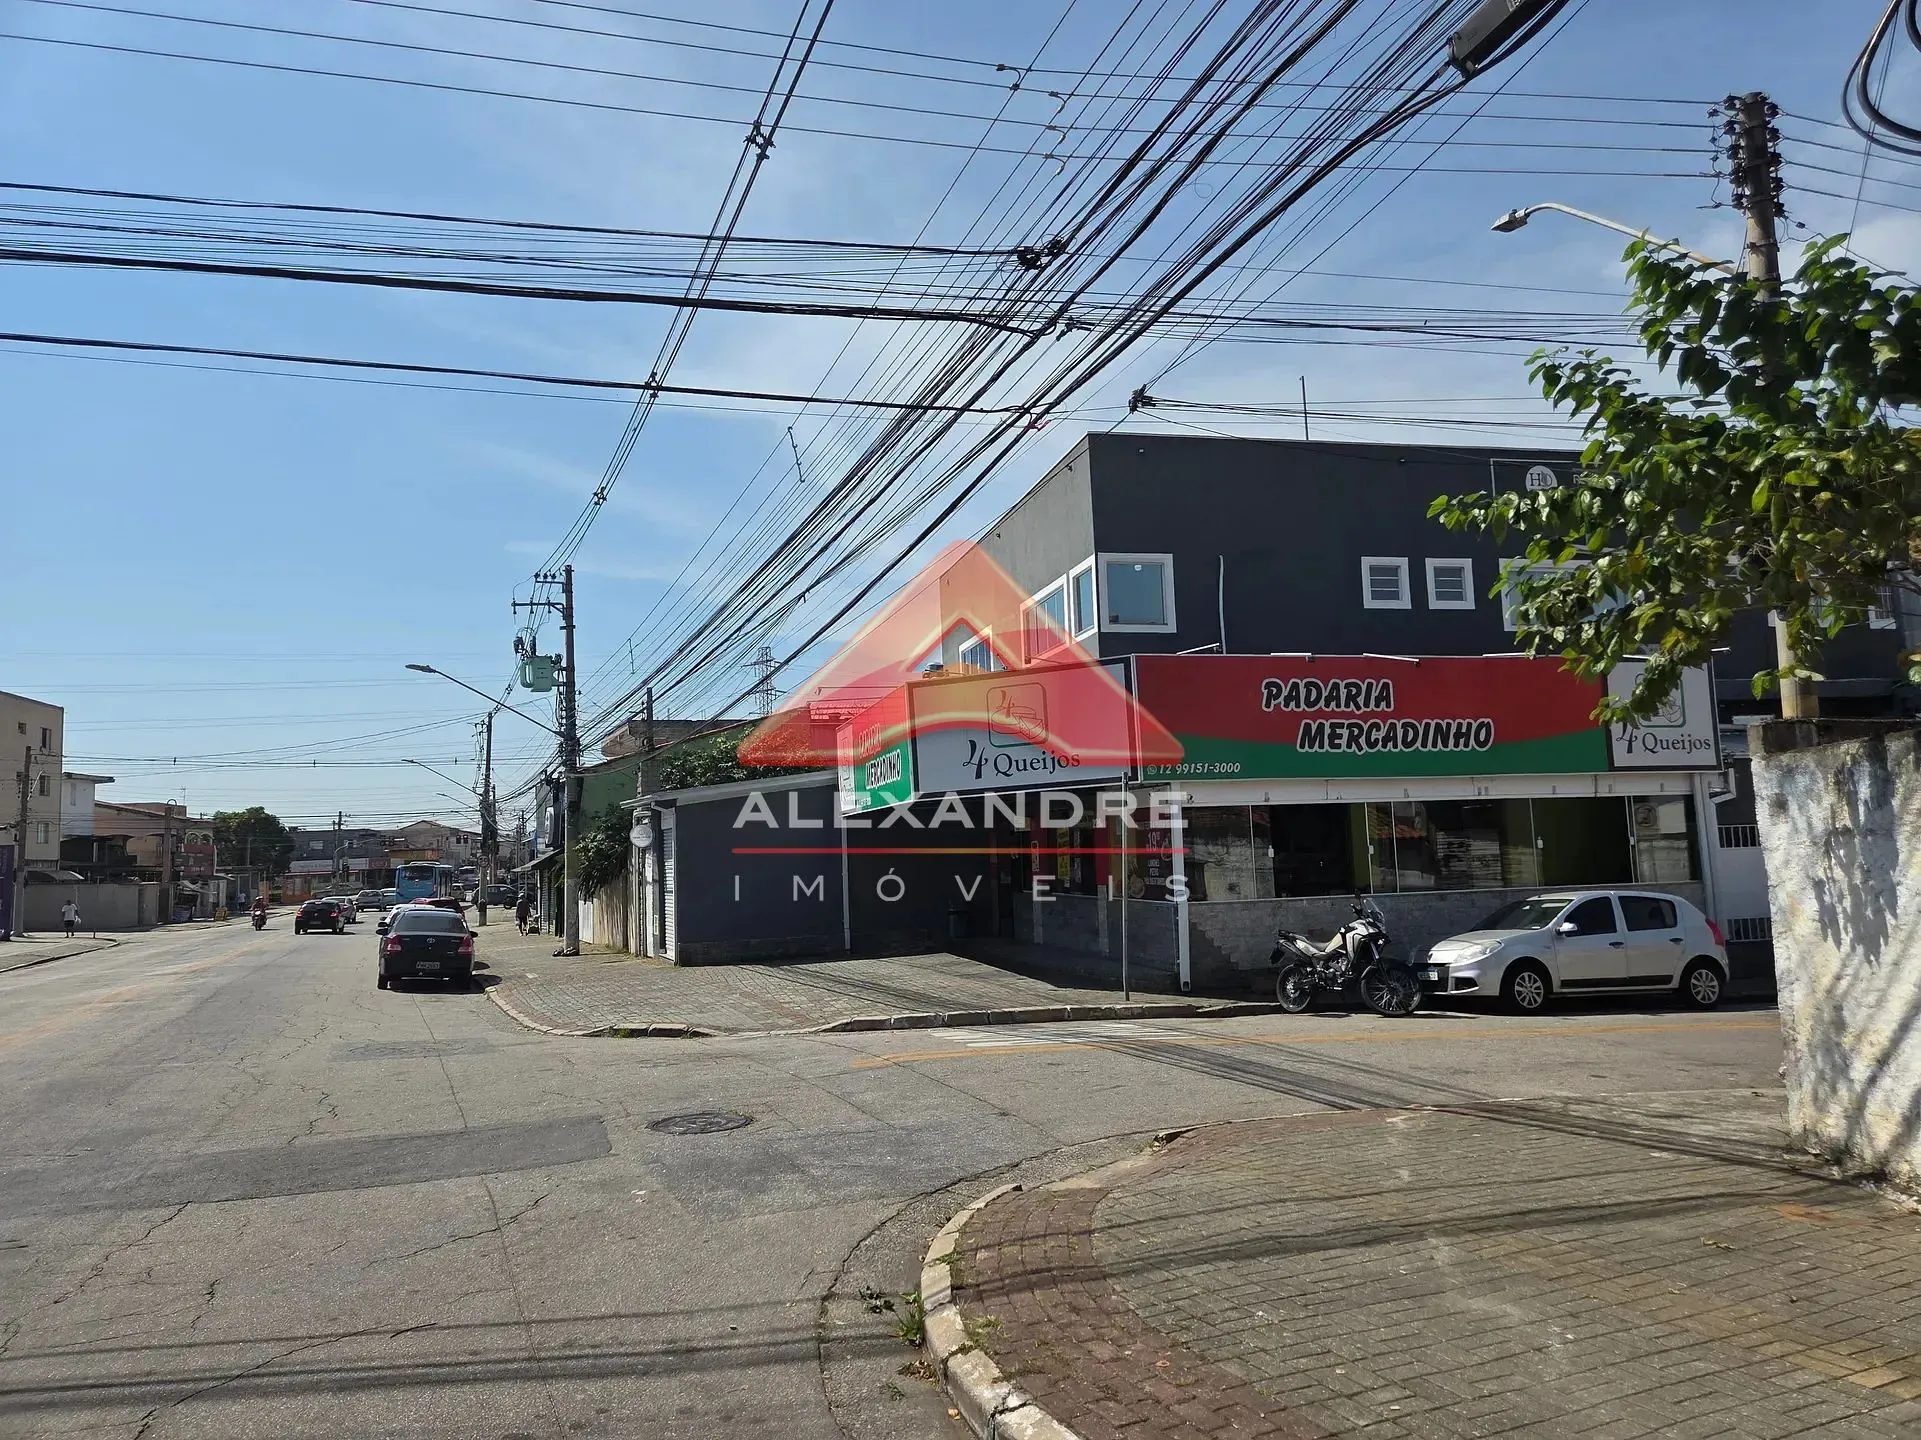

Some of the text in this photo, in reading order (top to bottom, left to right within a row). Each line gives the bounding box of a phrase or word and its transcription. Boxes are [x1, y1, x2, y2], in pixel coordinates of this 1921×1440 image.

[1261, 678, 1394, 713] PADARIA
[1297, 718, 1494, 753] MERCADINHO
[1616, 721, 1711, 754] 4 Queijos
[962, 739, 1081, 780] 4 Queijos
[1159, 762, 1241, 774] 12 99151-3000
